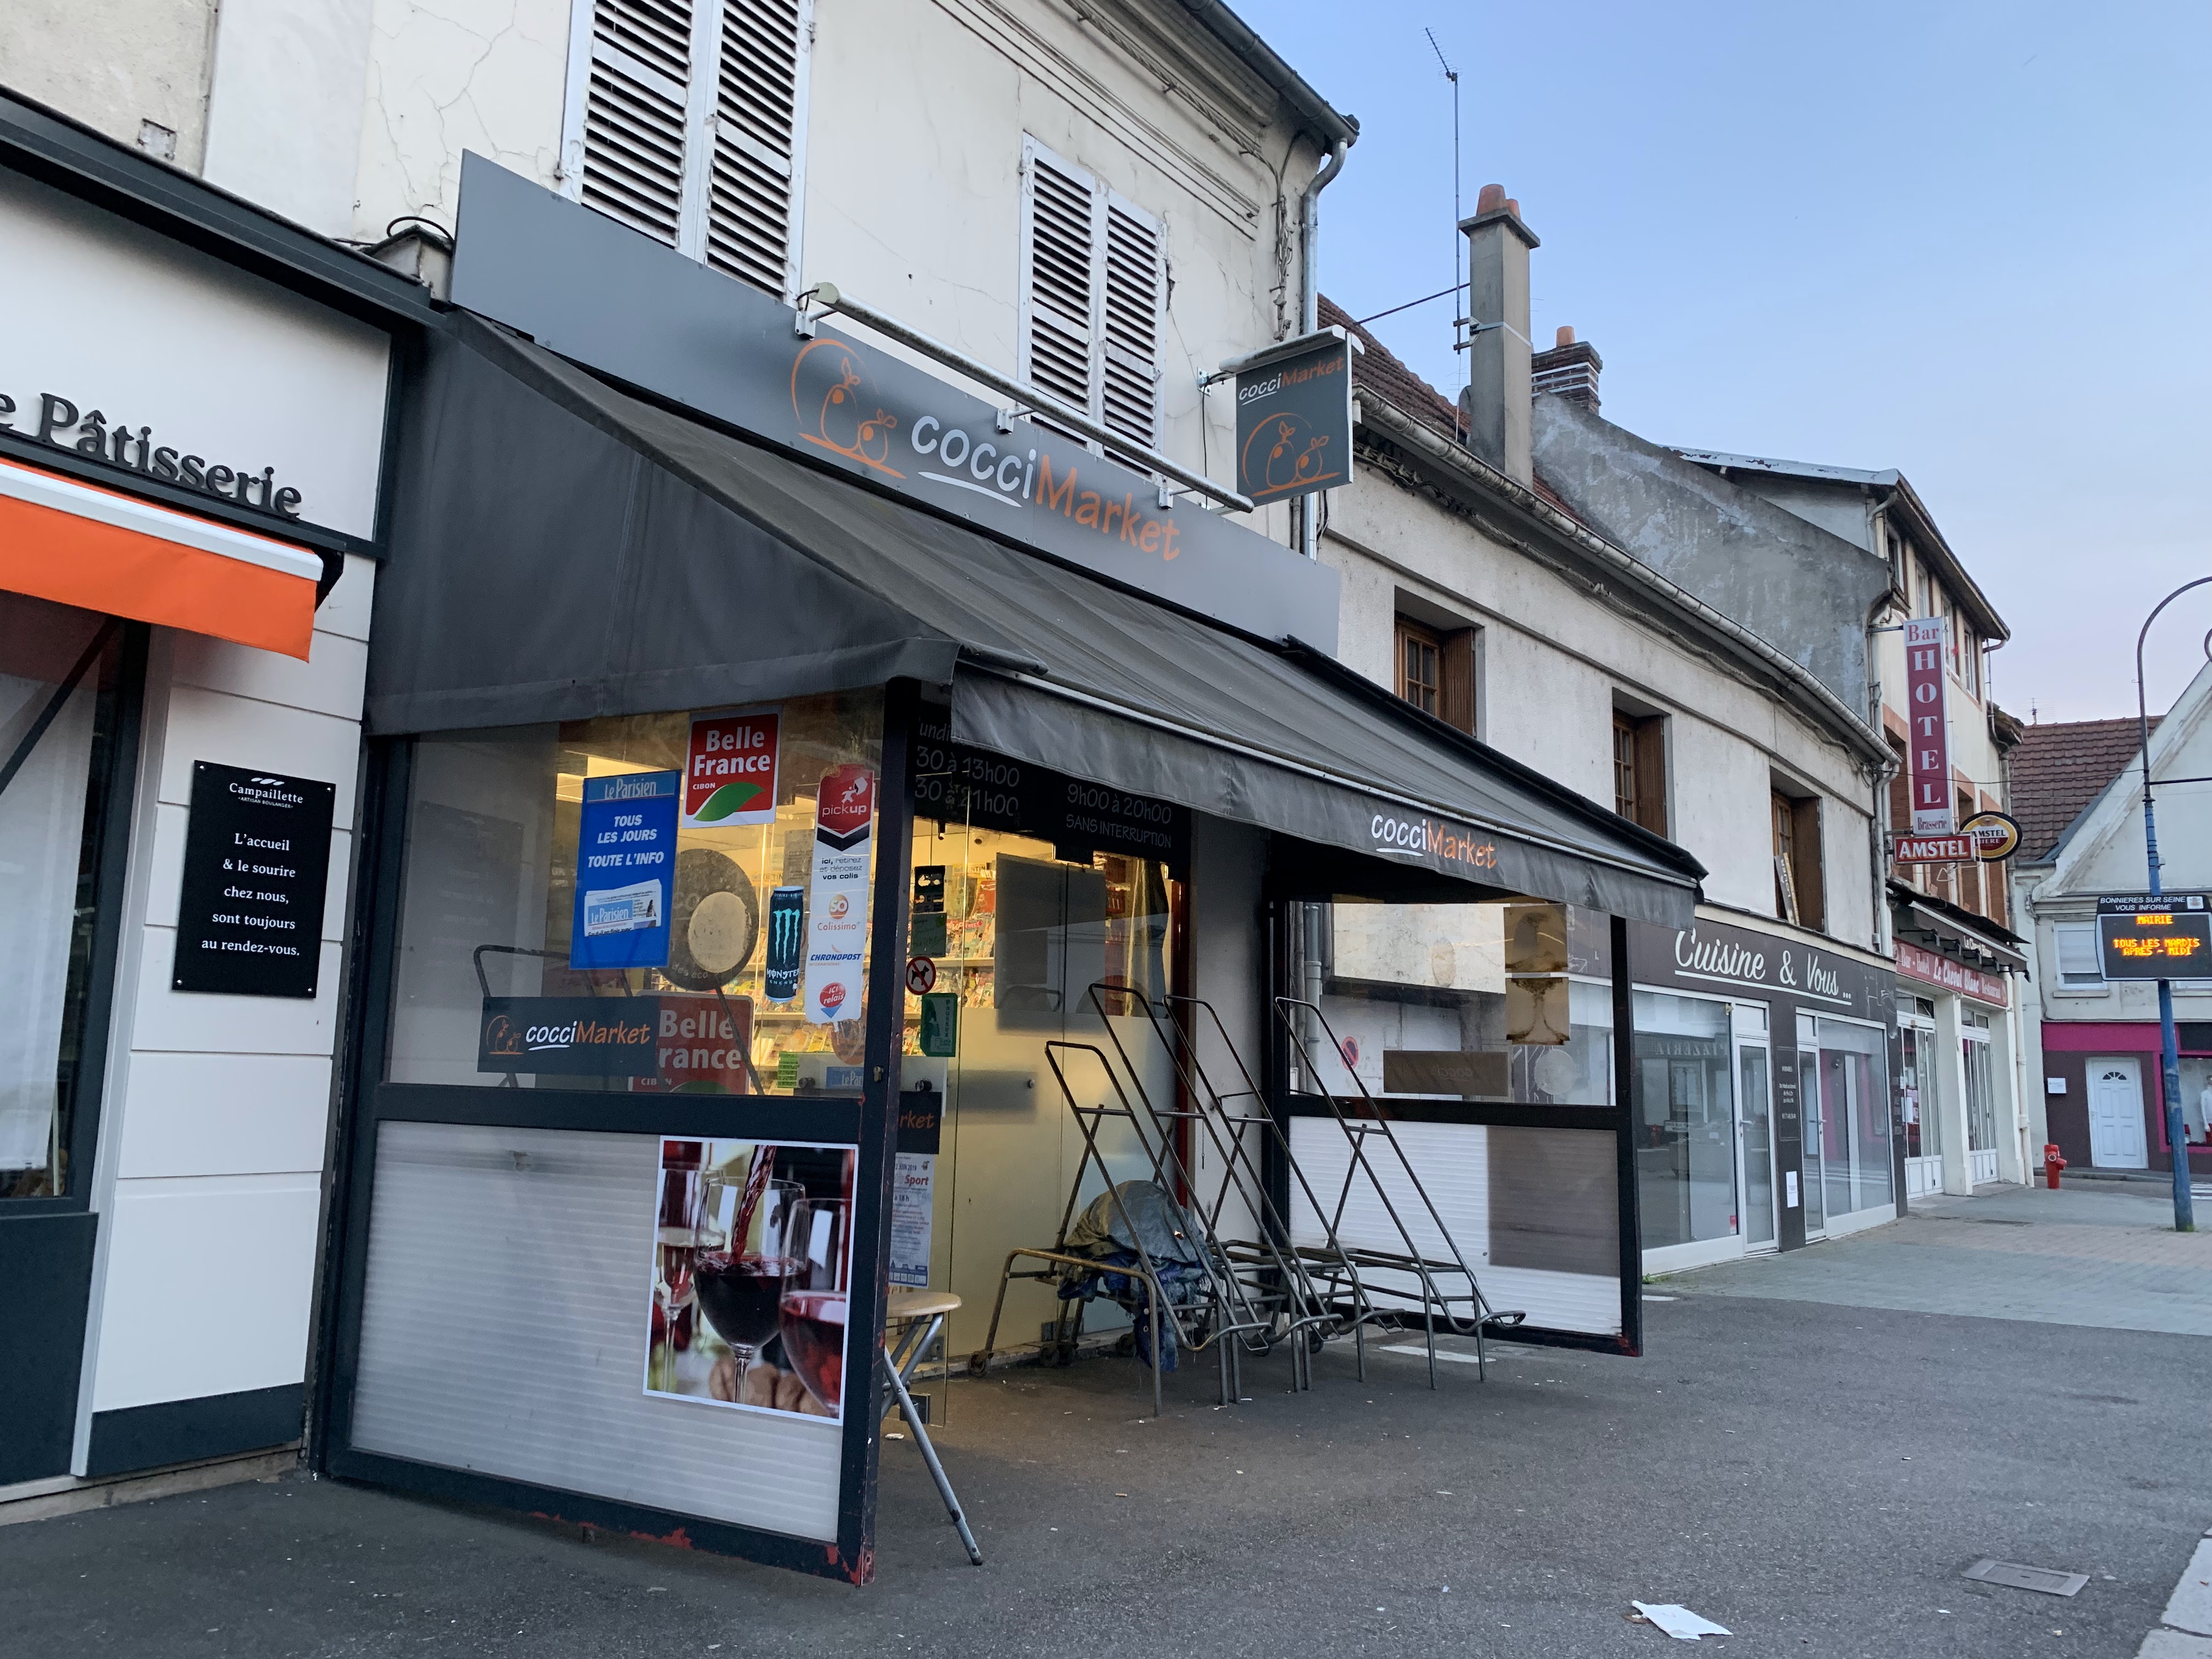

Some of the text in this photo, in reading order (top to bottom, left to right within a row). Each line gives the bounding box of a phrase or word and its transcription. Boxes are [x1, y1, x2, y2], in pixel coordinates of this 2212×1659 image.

[40, 392, 302, 522] Pâtisserie
[1908, 625, 1939, 642] Bar
[918, 722, 951, 741] undi
[1913, 649, 1941, 804] HOTEL
[706, 726, 765, 752] Belle
[695, 753, 771, 776] France
[916, 746, 1019, 787] 30 à 13h00
[229, 783, 303, 804] Campaillette
[605, 778, 657, 800] Le Parisien
[915, 777, 942, 801] 30
[822, 804, 867, 818] pickup
[1067, 784, 1172, 823] 9h00 à 20h00
[614, 815, 642, 827] TOUS
[1917, 816, 1947, 830] Brasserie
[597, 829, 657, 844] LES JOURS
[1066, 814, 1172, 848] SANS INTERRUPTION
[235, 833, 290, 850] L'accueil
[1899, 839, 1969, 859] AMSTEL
[223, 859, 296, 878] & le sourire
[588, 851, 664, 868] TOUTE L'INFO
[224, 887, 289, 904] chez nous,
[212, 913, 296, 930] sont toujours
[600, 907, 629, 923] Parisien
[2137, 915, 2173, 924] MAIRIE
[817, 922, 857, 931] Colissimo
[202, 939, 300, 956] au rendez-vous.
[2113, 938, 2200, 947] TOUS LES MARDIS
[2123, 947, 2153, 956] APRES
[2168, 947, 2192, 956] MIDI
[810, 953, 862, 961] CHRONOPOST
[1675, 928, 1765, 980] Cuisine
[1780, 950, 1797, 986] &
[1901, 946, 1911, 968] Bar
[1933, 957, 1941, 981] Le
[1943, 961, 1962, 988] Cheval
[659, 1009, 733, 1040] Belle
[659, 1047, 743, 1069] rance
[905, 1174, 929, 1186] Sport
